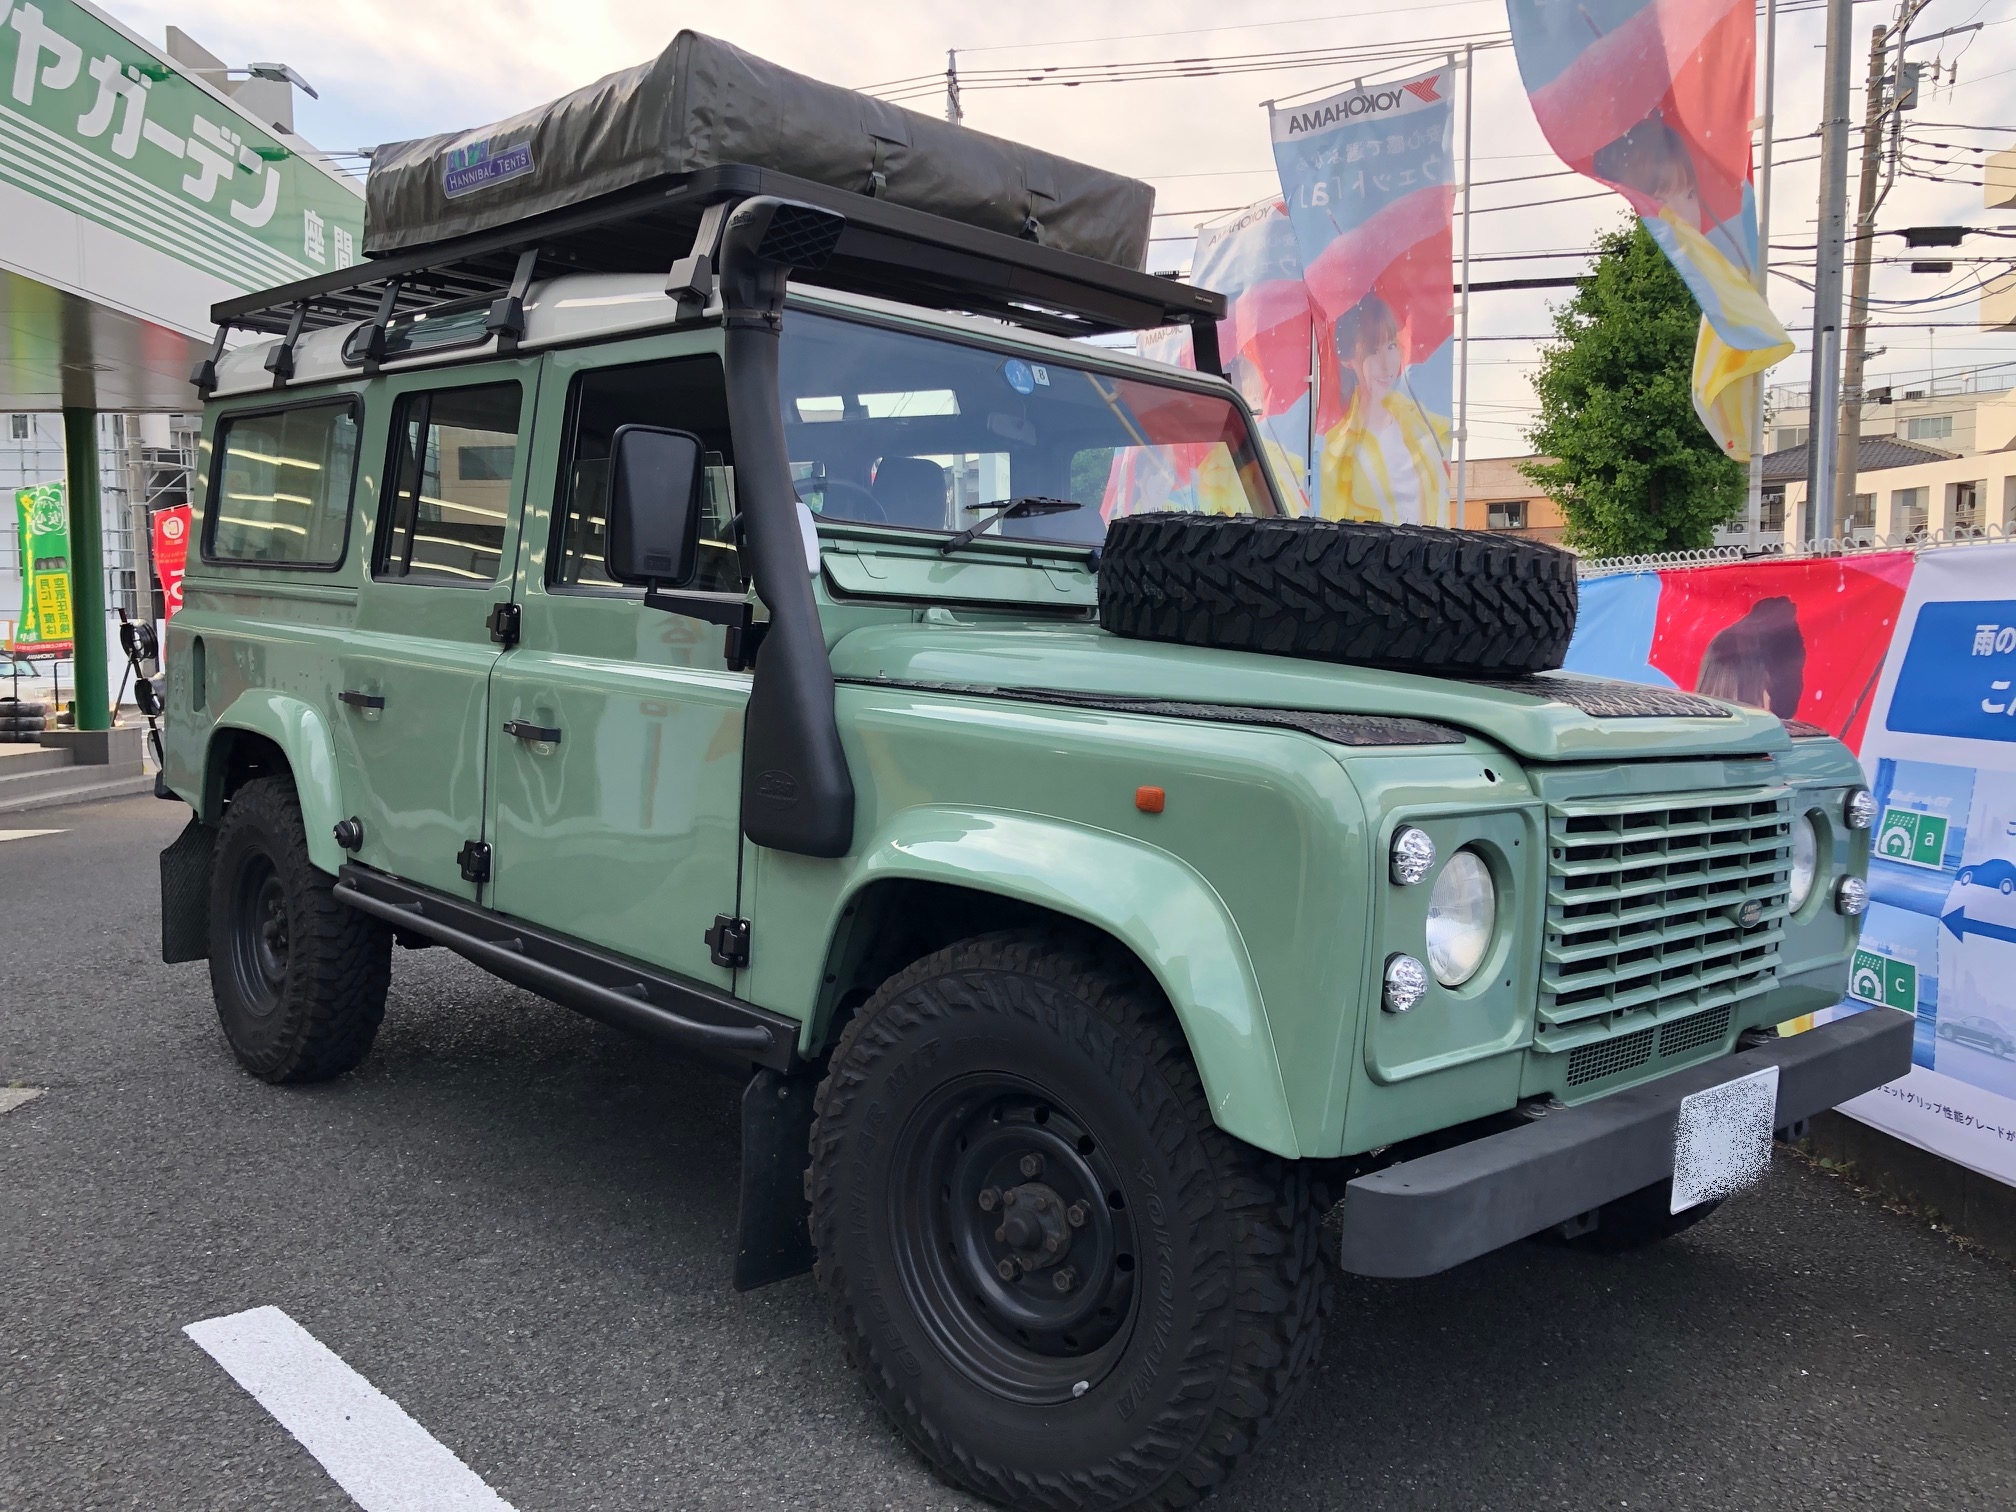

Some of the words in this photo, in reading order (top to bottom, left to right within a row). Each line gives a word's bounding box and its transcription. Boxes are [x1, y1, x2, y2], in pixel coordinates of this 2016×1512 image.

[0, 0, 280, 228] ヤガーデン
[449, 162, 495, 189] HANNIBAL
[497, 153, 527, 174] TENTS
[1972, 624, 2016, 656] 雨の
[1924, 832, 1935, 847] a
